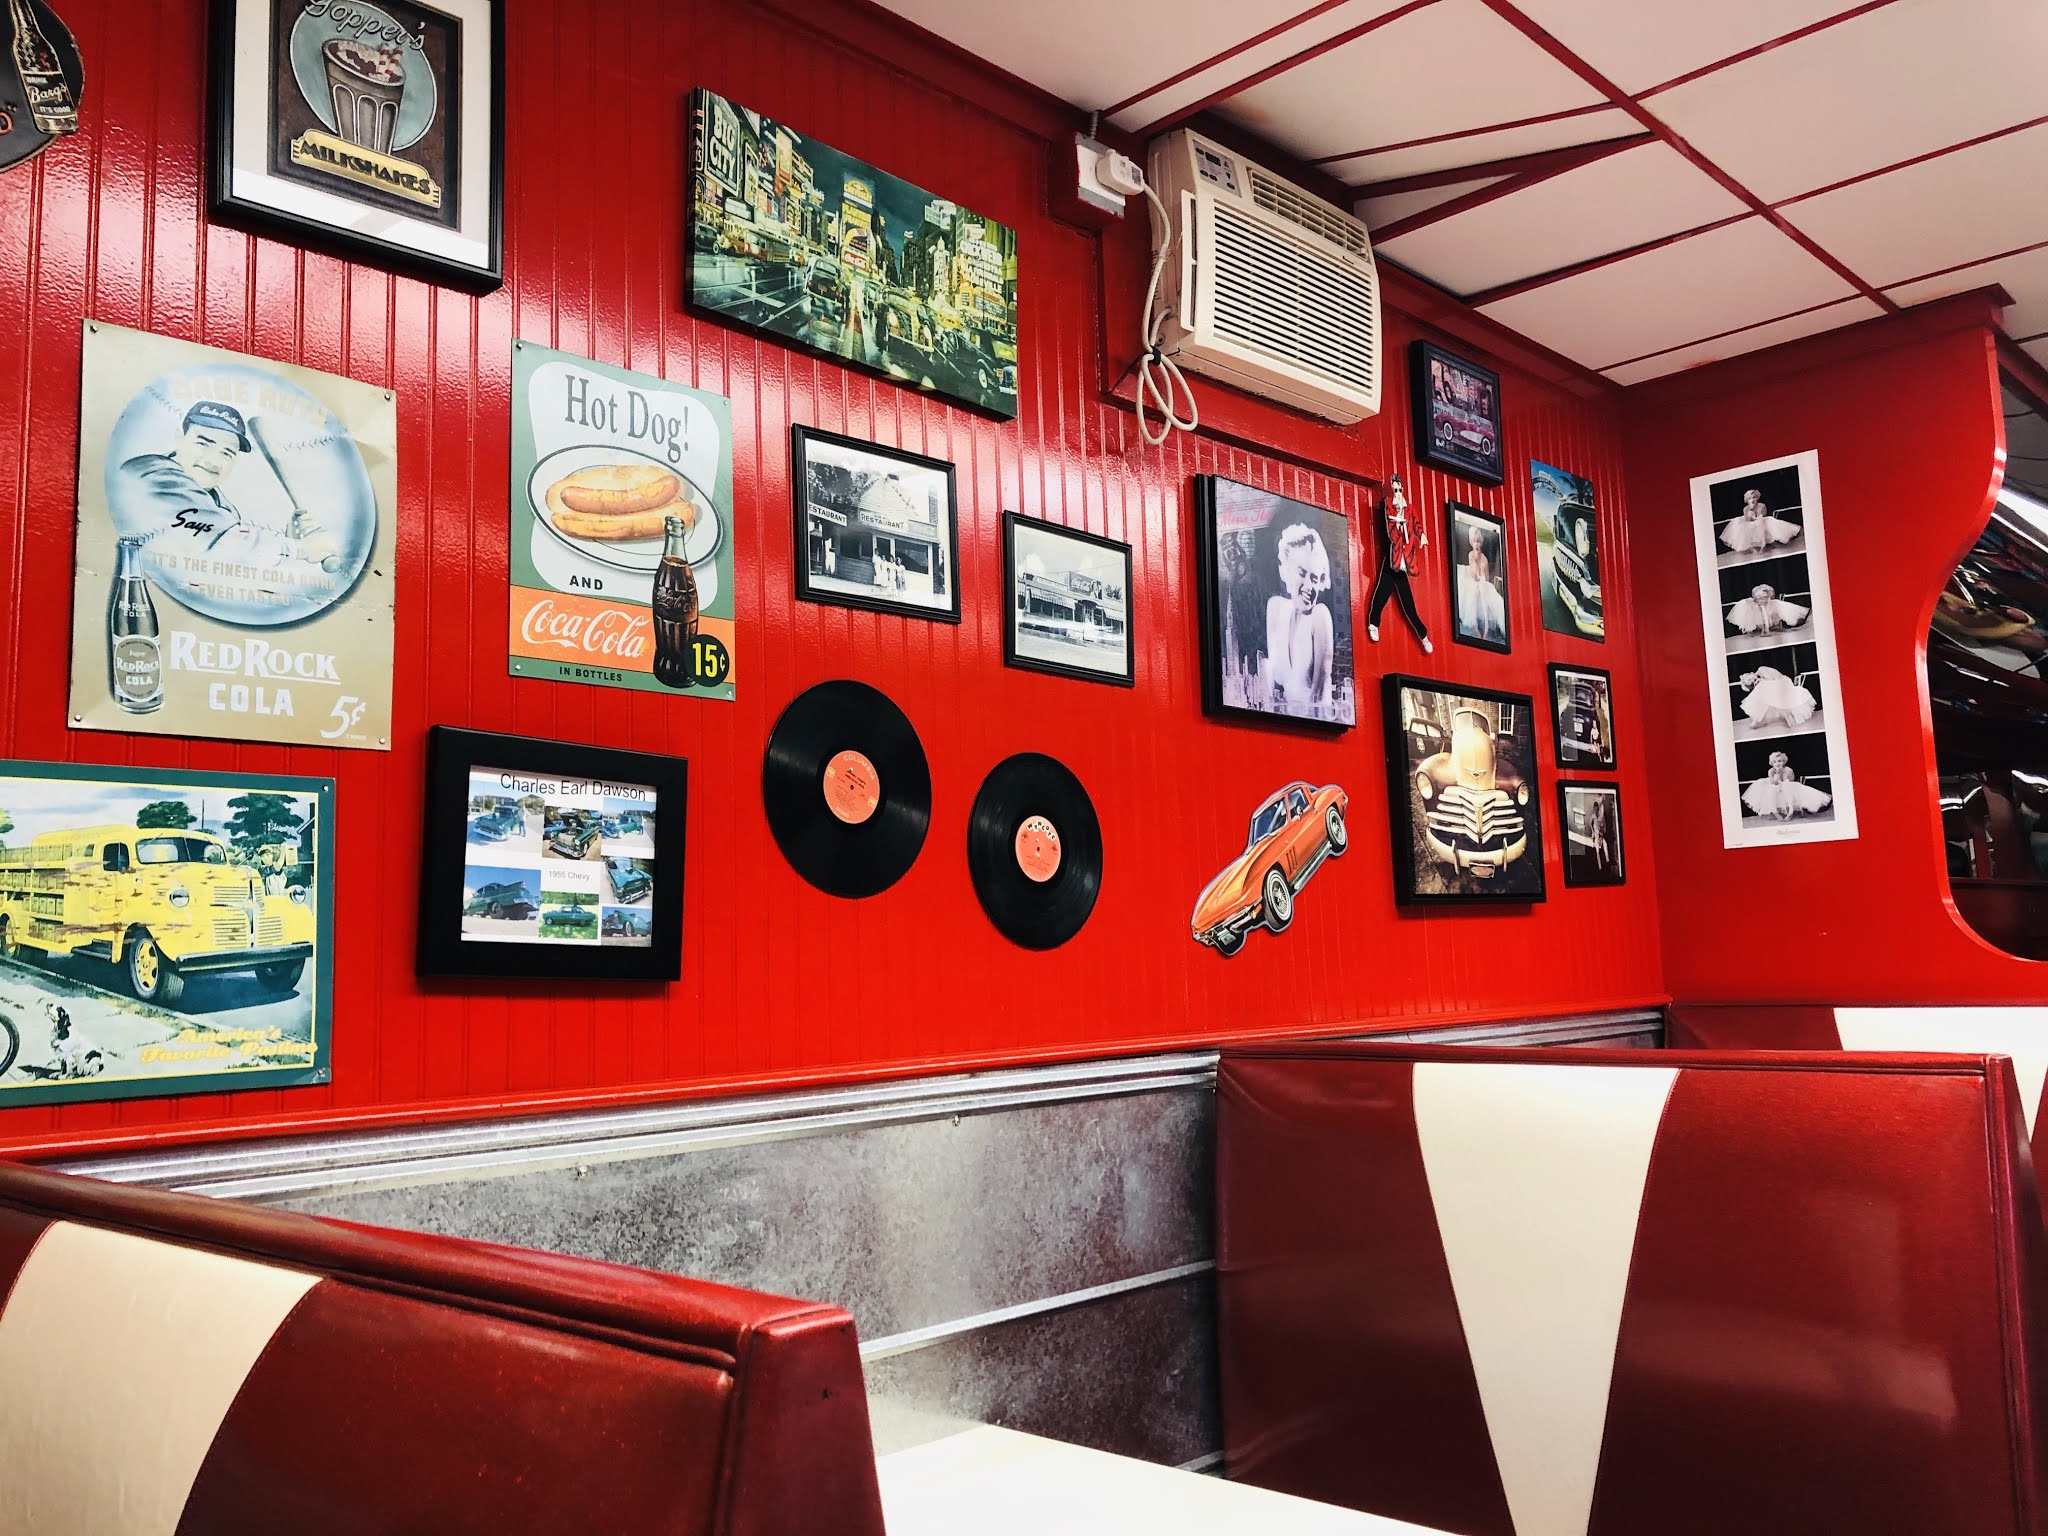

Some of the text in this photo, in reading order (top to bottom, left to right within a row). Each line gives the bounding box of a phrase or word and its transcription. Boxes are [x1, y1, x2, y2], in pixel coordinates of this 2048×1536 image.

[713, 104, 735, 152] BIG
[300, 140, 431, 195] MILKSHAKES
[709, 135, 735, 181] CITY
[565, 374, 689, 464] Hot Dog!
[171, 508, 214, 537] Says
[860, 512, 905, 530] RESTAURANT
[183, 556, 208, 574] THE
[212, 561, 258, 580] FINEST
[262, 568, 295, 585] COLA
[569, 575, 603, 590] AND
[198, 582, 234, 600] EVER
[521, 599, 650, 658] Coca-Cola
[559, 666, 623, 682] IN BOTTLES
[209, 682, 294, 717] COLA
[843, 754, 876, 781] COLUMBIA
[500, 773, 646, 802] Charles Earl Dawson
[548, 870, 591, 882] 1955 Chevy
